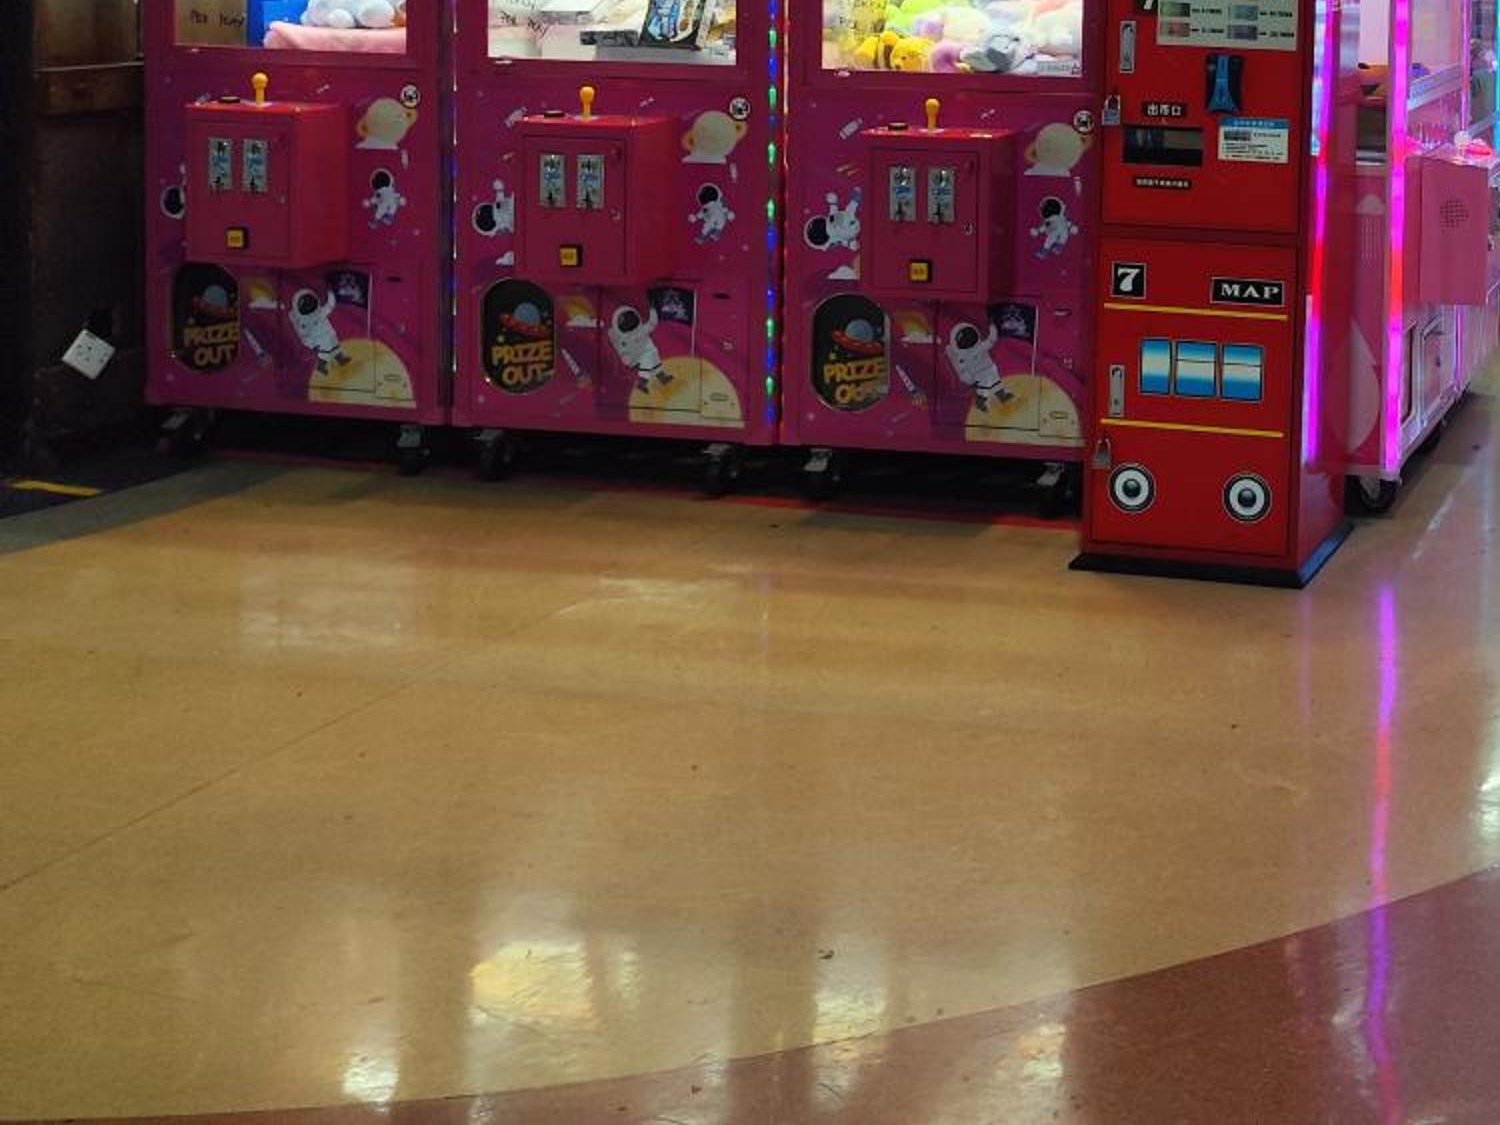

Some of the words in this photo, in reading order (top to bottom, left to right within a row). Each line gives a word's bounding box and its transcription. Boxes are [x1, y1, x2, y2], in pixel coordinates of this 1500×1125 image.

[1117, 267, 1141, 292] 7
[1220, 281, 1281, 300] MAP
[183, 322, 241, 349] PRIZE
[194, 343, 237, 367] OUT
[491, 344, 555, 367] PRIZE
[823, 356, 887, 381] PRIZE
